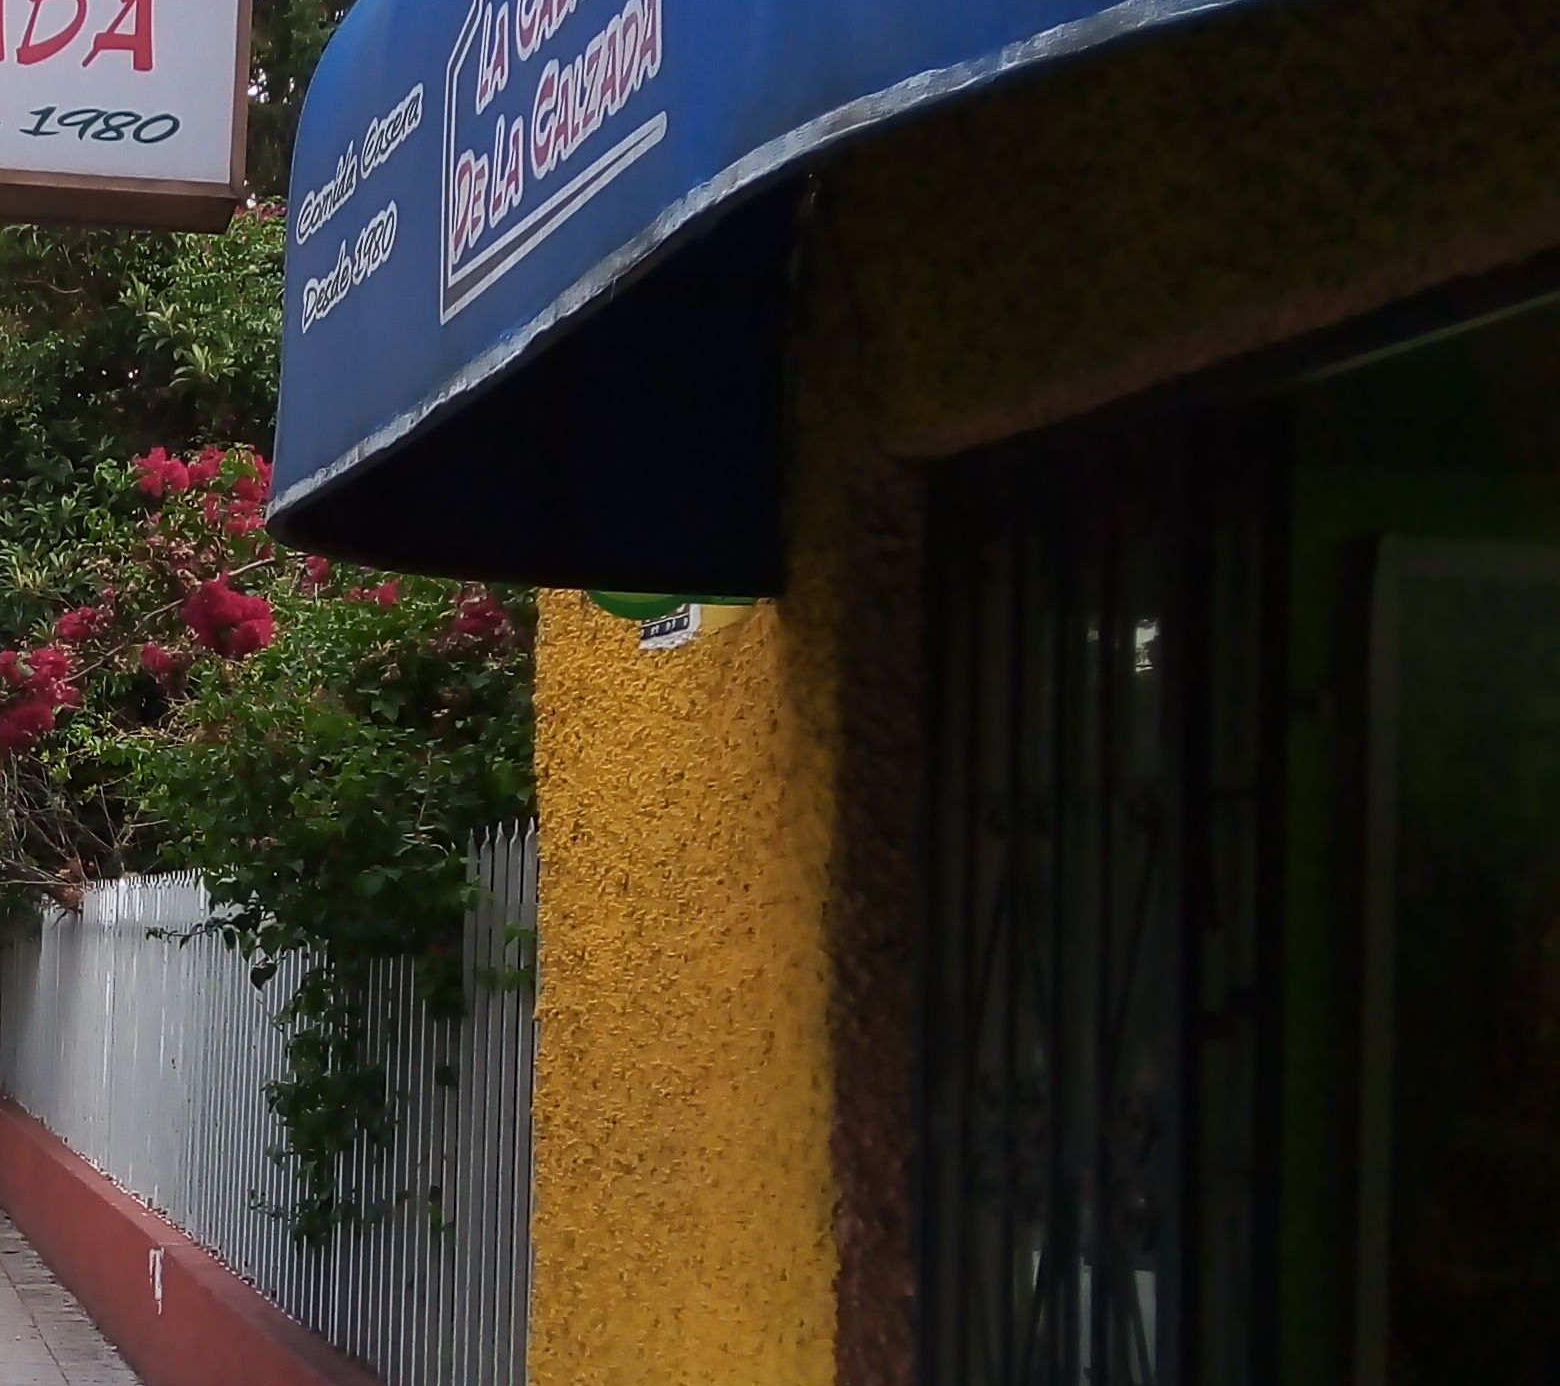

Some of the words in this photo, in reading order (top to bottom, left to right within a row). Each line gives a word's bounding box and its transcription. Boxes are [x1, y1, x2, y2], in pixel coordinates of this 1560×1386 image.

[18, 105, 182, 144] 1980
[476, 1, 509, 115] LA
[296, 140, 358, 245] Comida
[361, 82, 424, 179] Casera
[451, 149, 488, 264] DE
[490, 114, 524, 228] LA
[302, 239, 352, 334] Desde
[352, 200, 397, 285] 1980
